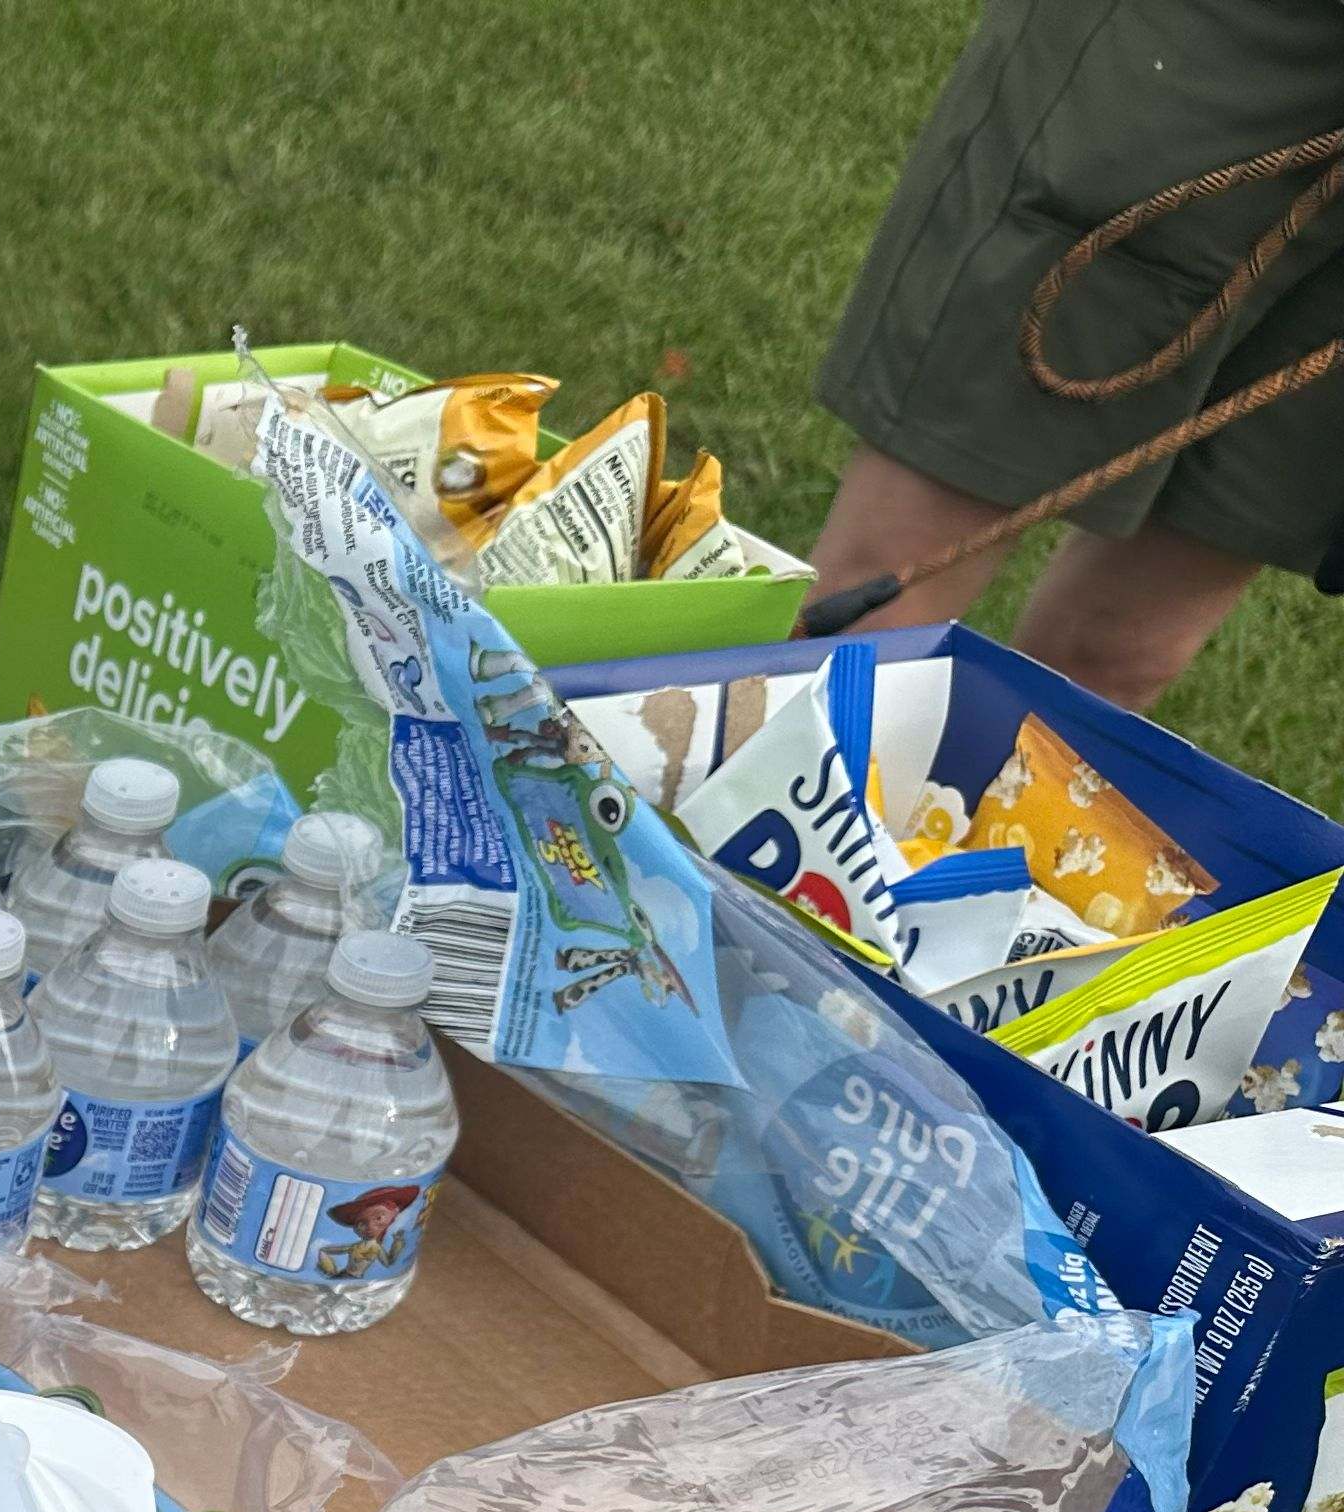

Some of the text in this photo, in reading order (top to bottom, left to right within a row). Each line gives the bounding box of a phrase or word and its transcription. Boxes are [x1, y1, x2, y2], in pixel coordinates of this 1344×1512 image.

[73, 563, 307, 742] positively
[1243, 1253, 1276, 1281] g)
[1223, 1270, 1264, 1315] (255
[1212, 1305, 1246, 1337] OZ
[1205, 1329, 1233, 1350] 9
